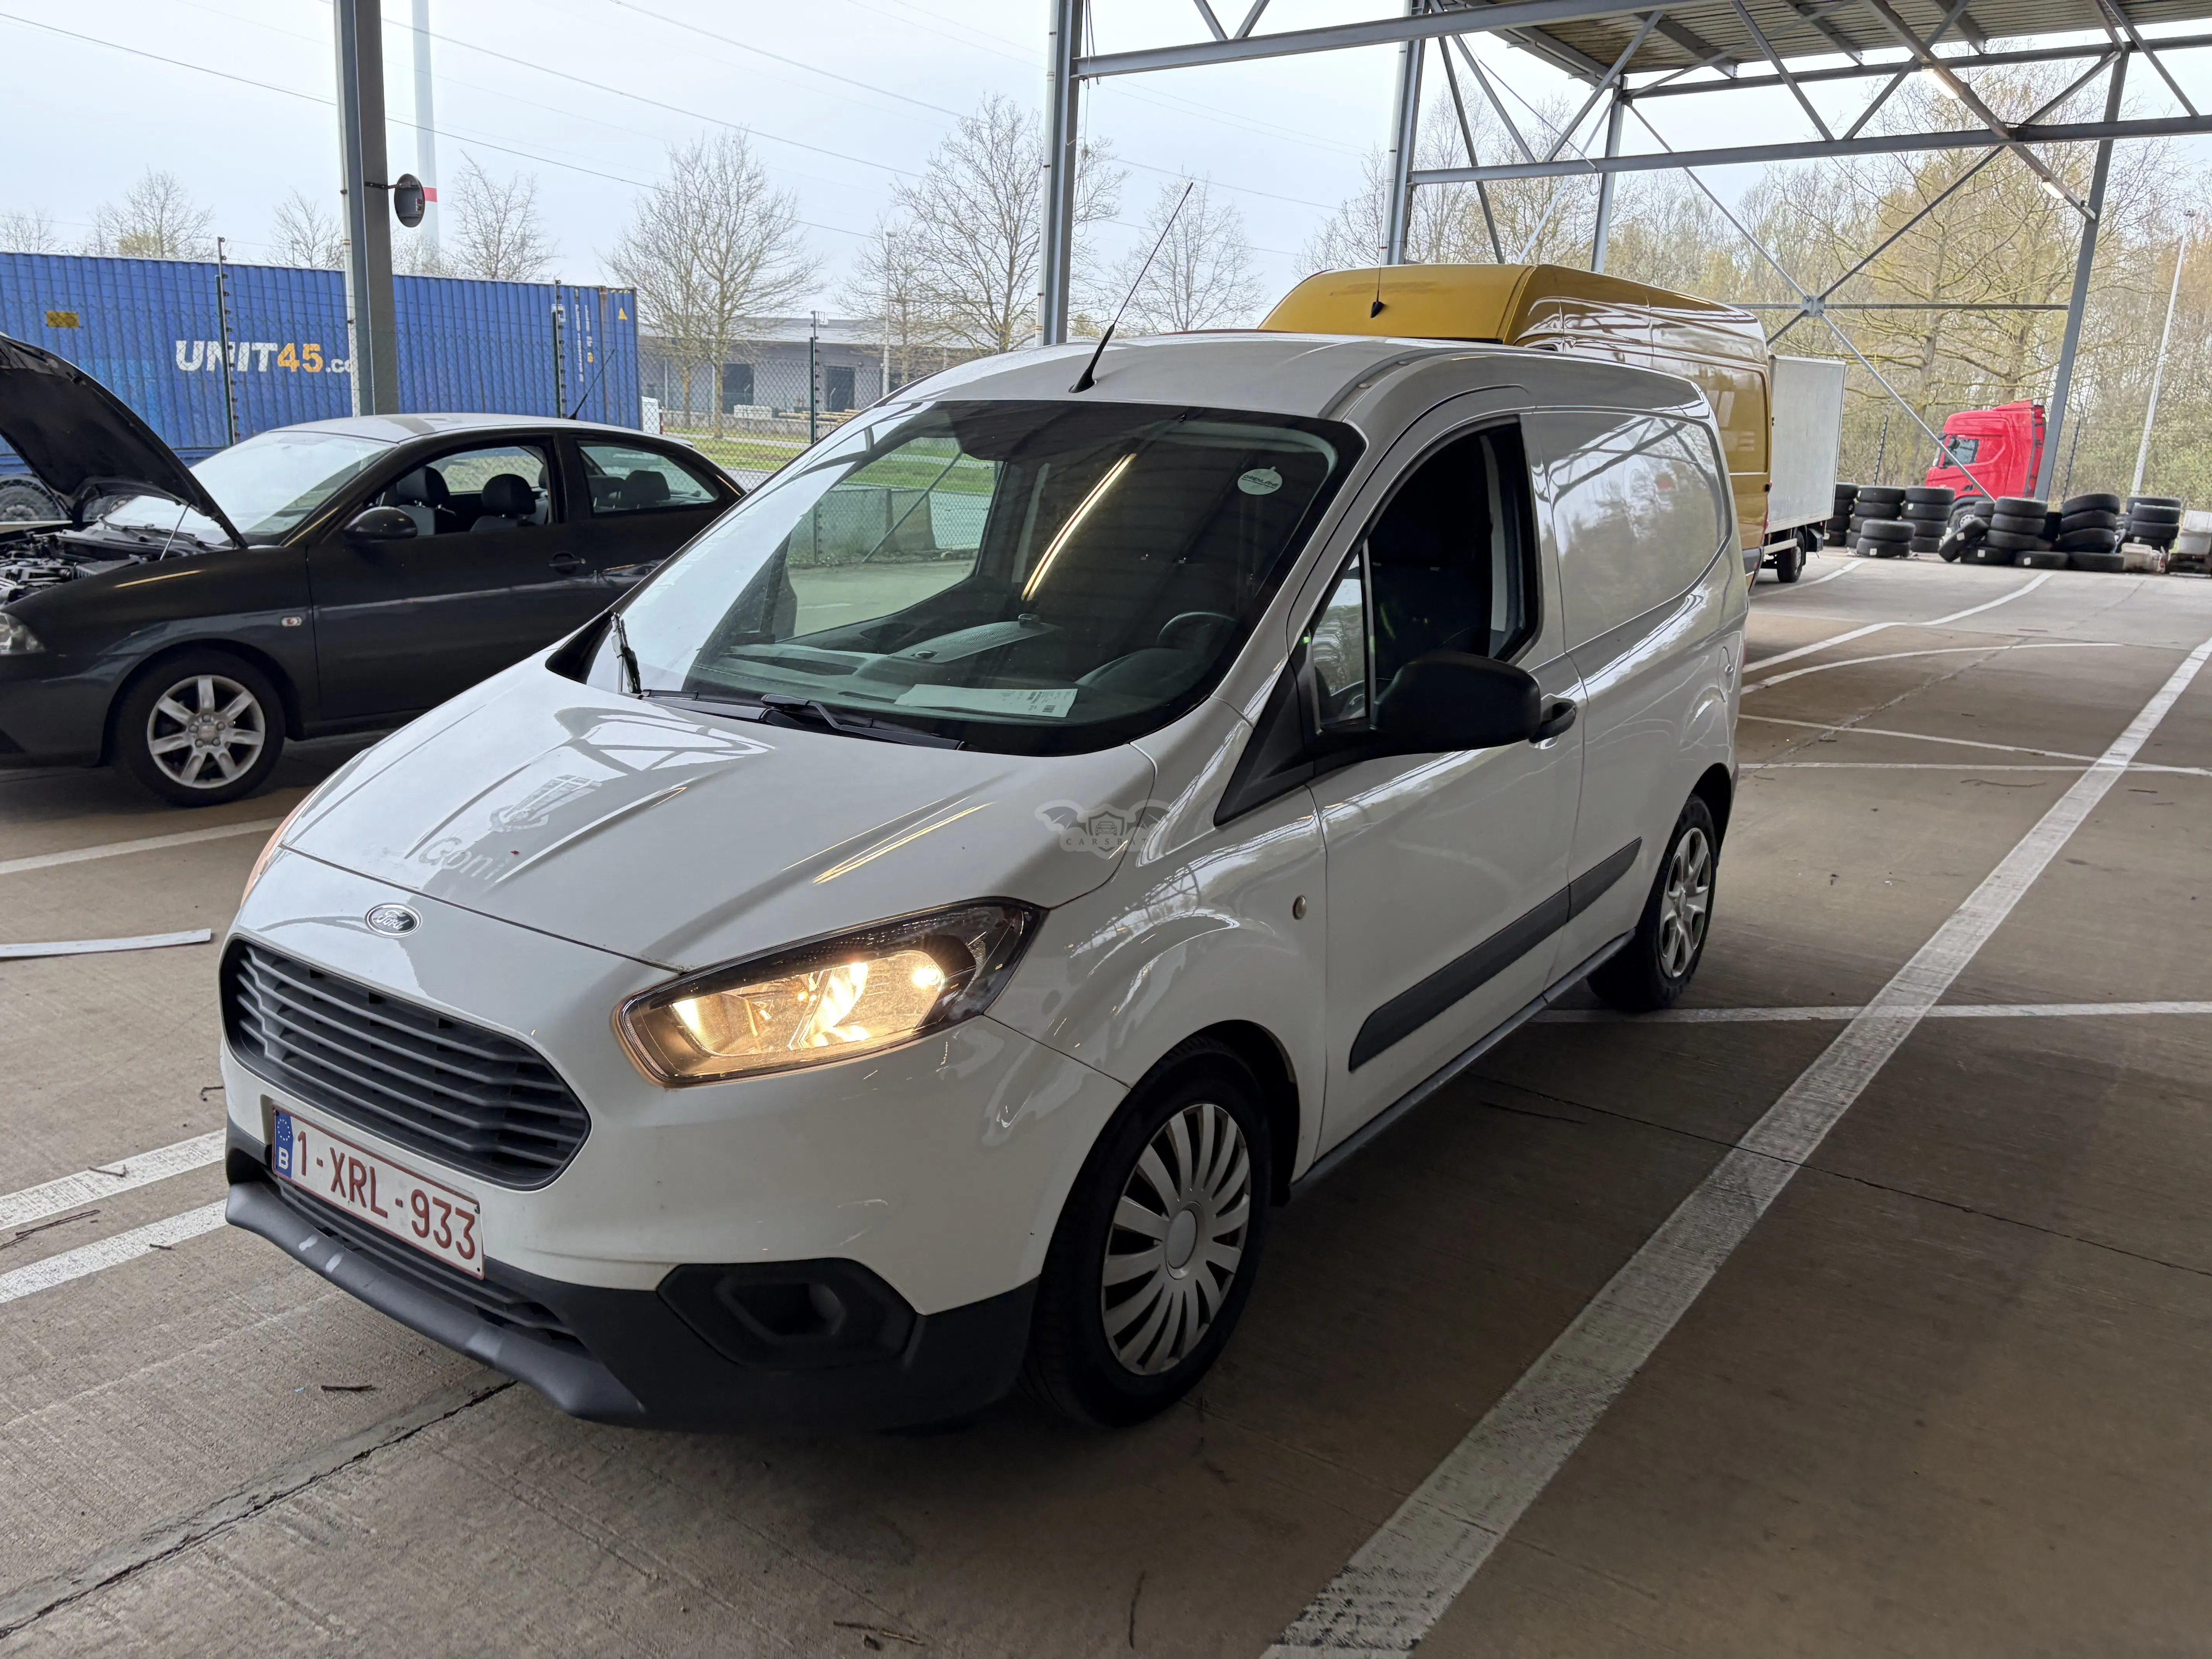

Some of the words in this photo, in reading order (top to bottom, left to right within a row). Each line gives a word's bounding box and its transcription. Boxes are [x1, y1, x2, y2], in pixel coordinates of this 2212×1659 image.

[376, 910, 409, 929] Ford
[278, 1147, 289, 1170] B
[297, 1130, 475, 1260] 1-XRL-933
